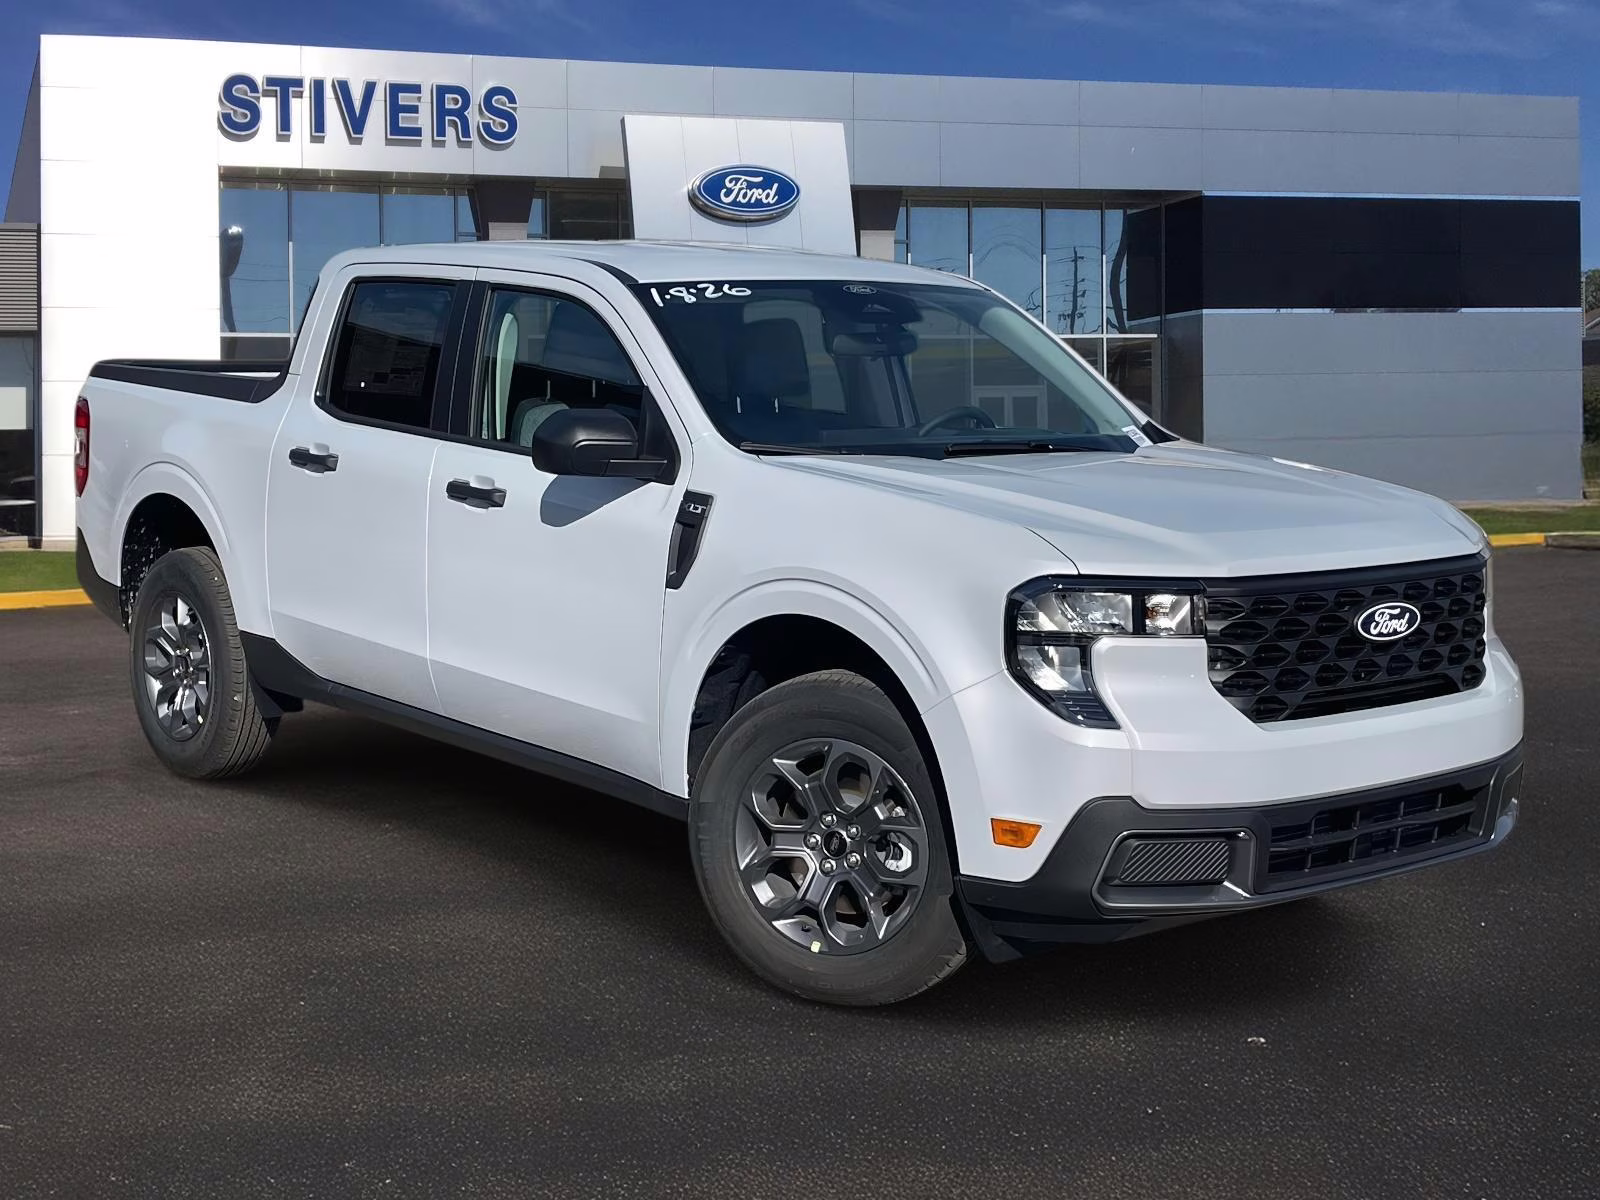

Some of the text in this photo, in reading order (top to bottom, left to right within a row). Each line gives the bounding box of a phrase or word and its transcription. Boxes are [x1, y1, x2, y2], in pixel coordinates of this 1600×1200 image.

[218, 72, 519, 147] STIVERS
[720, 174, 779, 204] Ford
[1370, 608, 1410, 635] Ford
